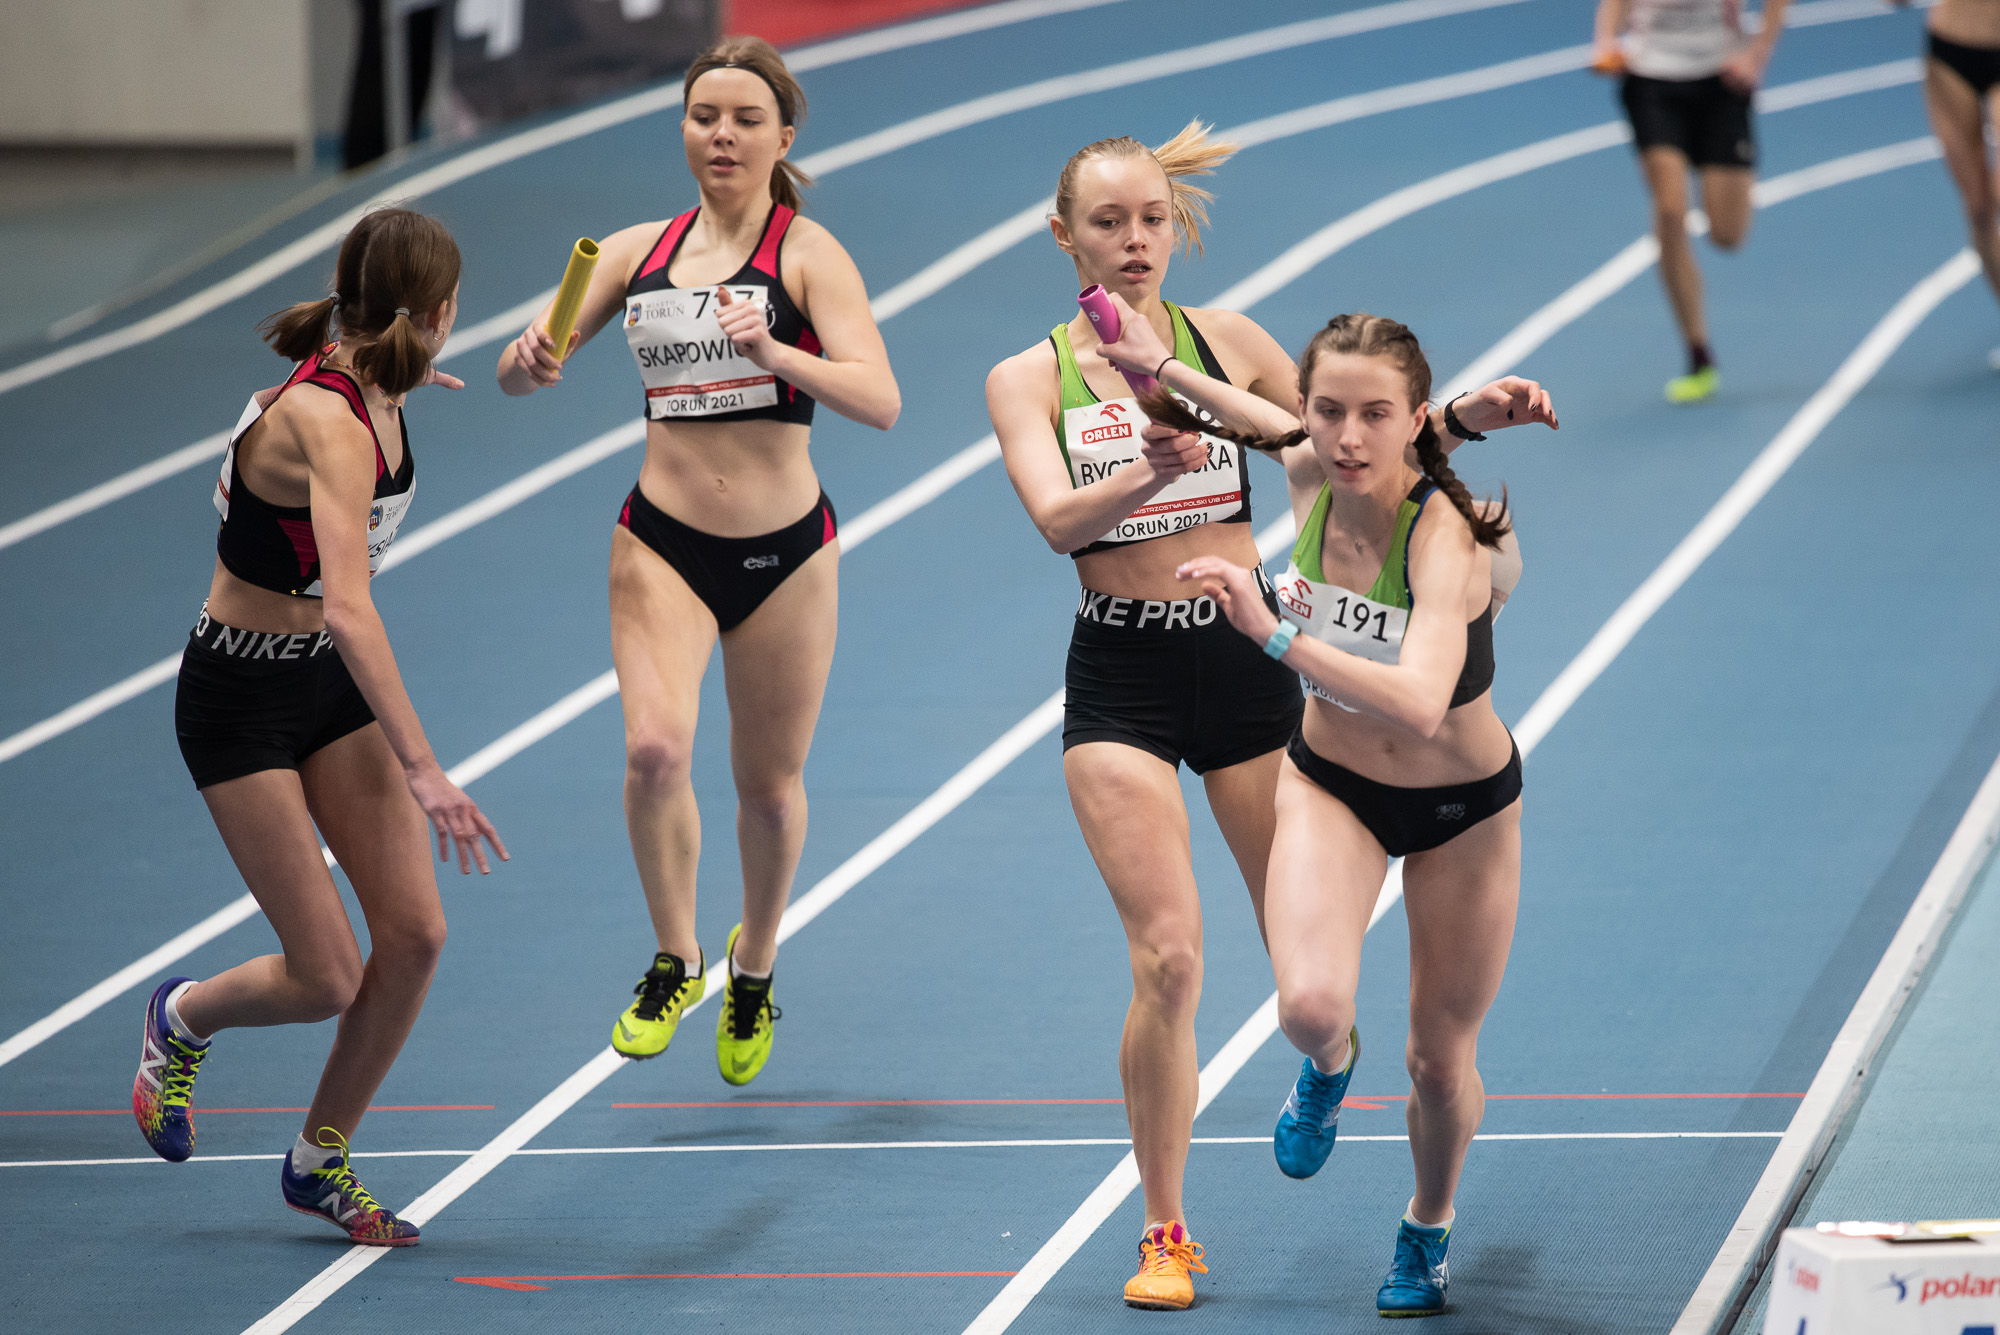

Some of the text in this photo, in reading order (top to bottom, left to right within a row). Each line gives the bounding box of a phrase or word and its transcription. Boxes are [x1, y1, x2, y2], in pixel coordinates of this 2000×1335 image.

[693, 290, 755, 319] 77
[1089, 311, 1100, 322] 8
[711, 393, 744, 410] 2021
[1084, 424, 1130, 443] ORLEN
[1184, 499, 1207, 508] POLSKI
[1115, 512, 1208, 539] TORUŃ 2021
[1137, 595, 1217, 630] PRO
[1333, 596, 1388, 643] 191
[211, 625, 311, 660] NIKE
